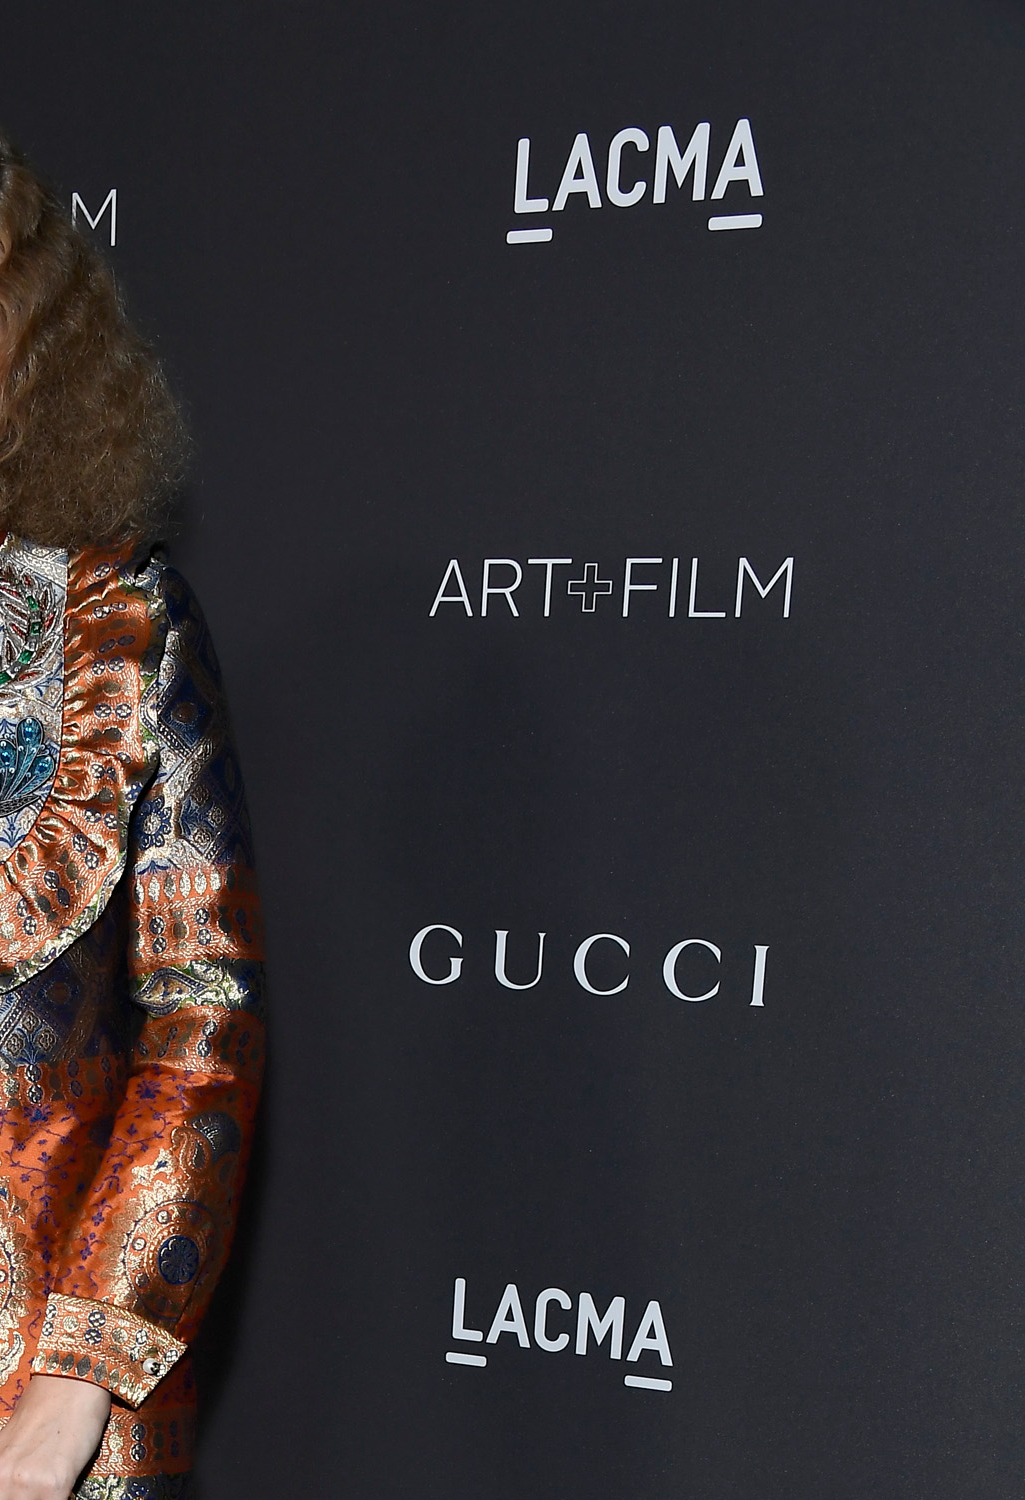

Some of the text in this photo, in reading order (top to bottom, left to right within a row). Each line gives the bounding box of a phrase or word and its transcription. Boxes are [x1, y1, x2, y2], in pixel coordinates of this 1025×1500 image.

[512, 118, 764, 214] LACMA
[428, 556, 794, 619] ART+FILM
[409, 924, 770, 1007] GUCCI
[451, 1277, 673, 1367] LACMA
